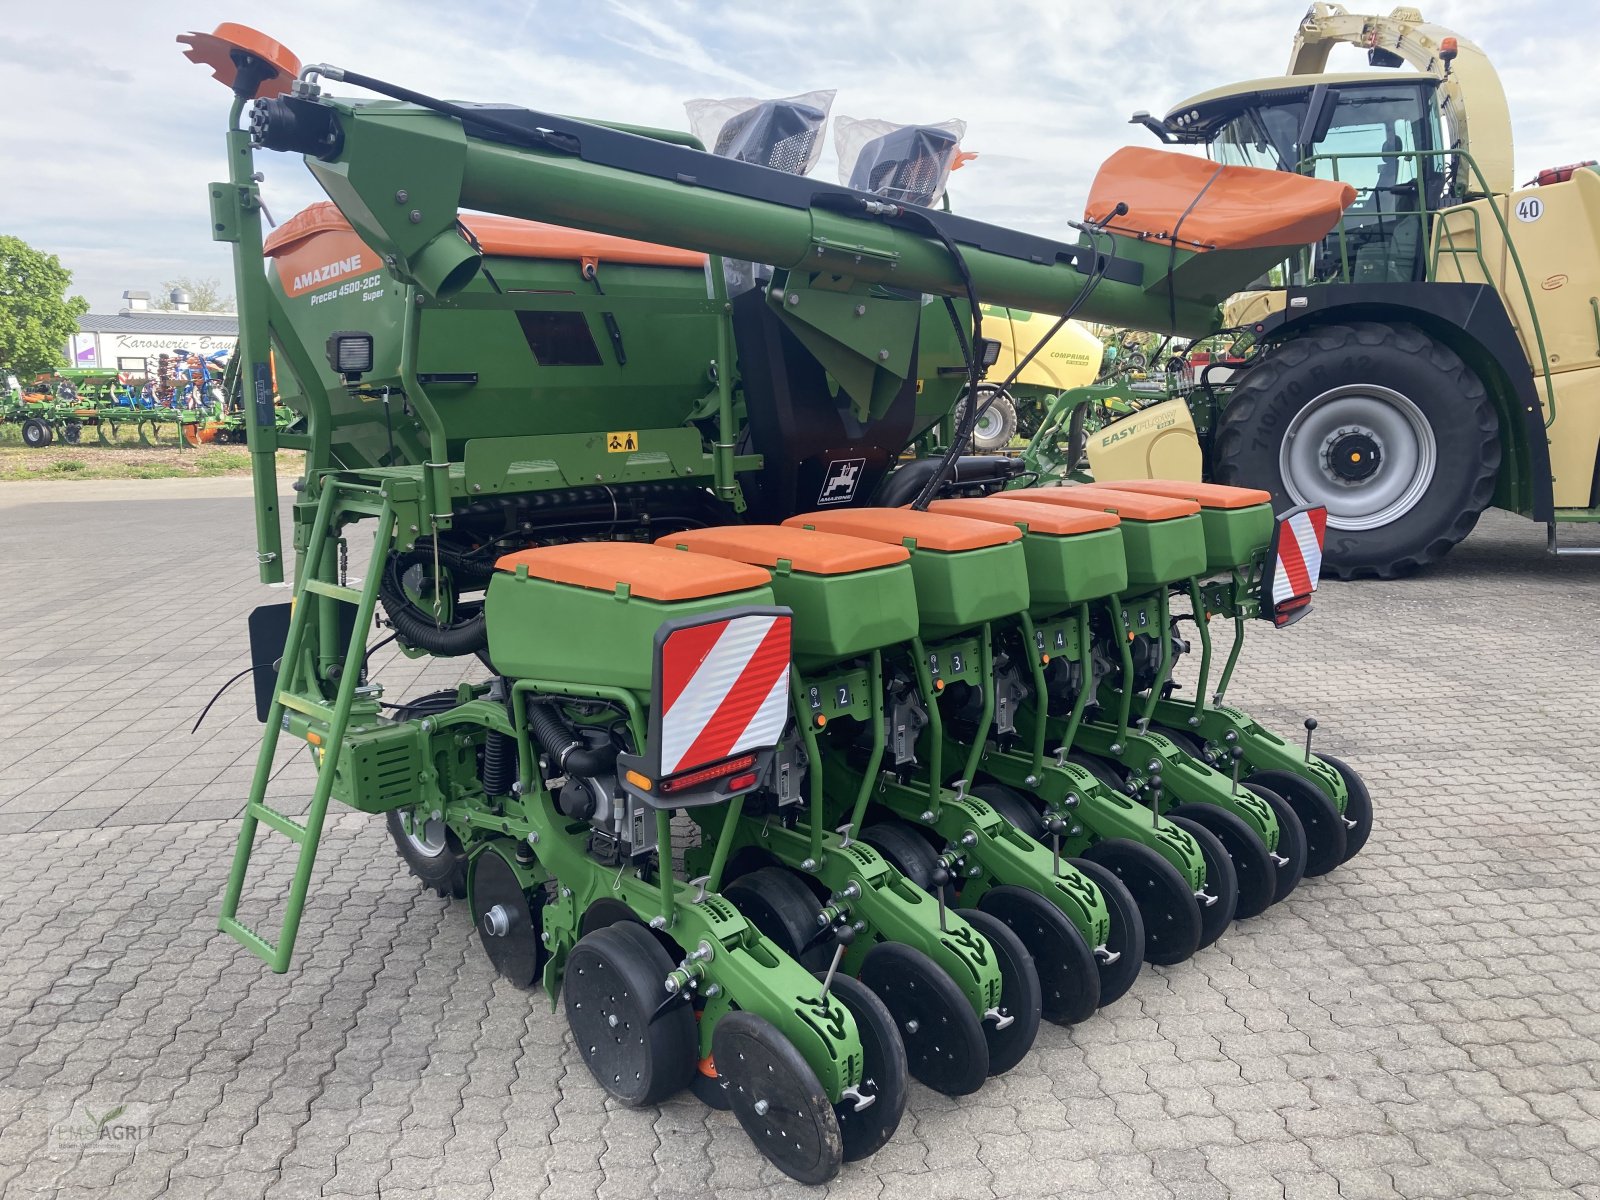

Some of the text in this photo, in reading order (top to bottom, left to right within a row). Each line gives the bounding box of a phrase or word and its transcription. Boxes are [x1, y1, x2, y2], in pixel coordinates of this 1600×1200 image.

[1519, 200, 1539, 219] 40
[293, 254, 362, 292] AMAZONE
[338, 275, 381, 297] 4500-2CC
[362, 289, 385, 303] Super
[1050, 351, 1090, 361] COMPRIMA
[819, 494, 852, 503] AMAZONE
[1140, 612, 1146, 625] 5
[1057, 632, 1063, 646] 4
[953, 655, 961, 671] 3
[839, 688, 848, 705] 2
